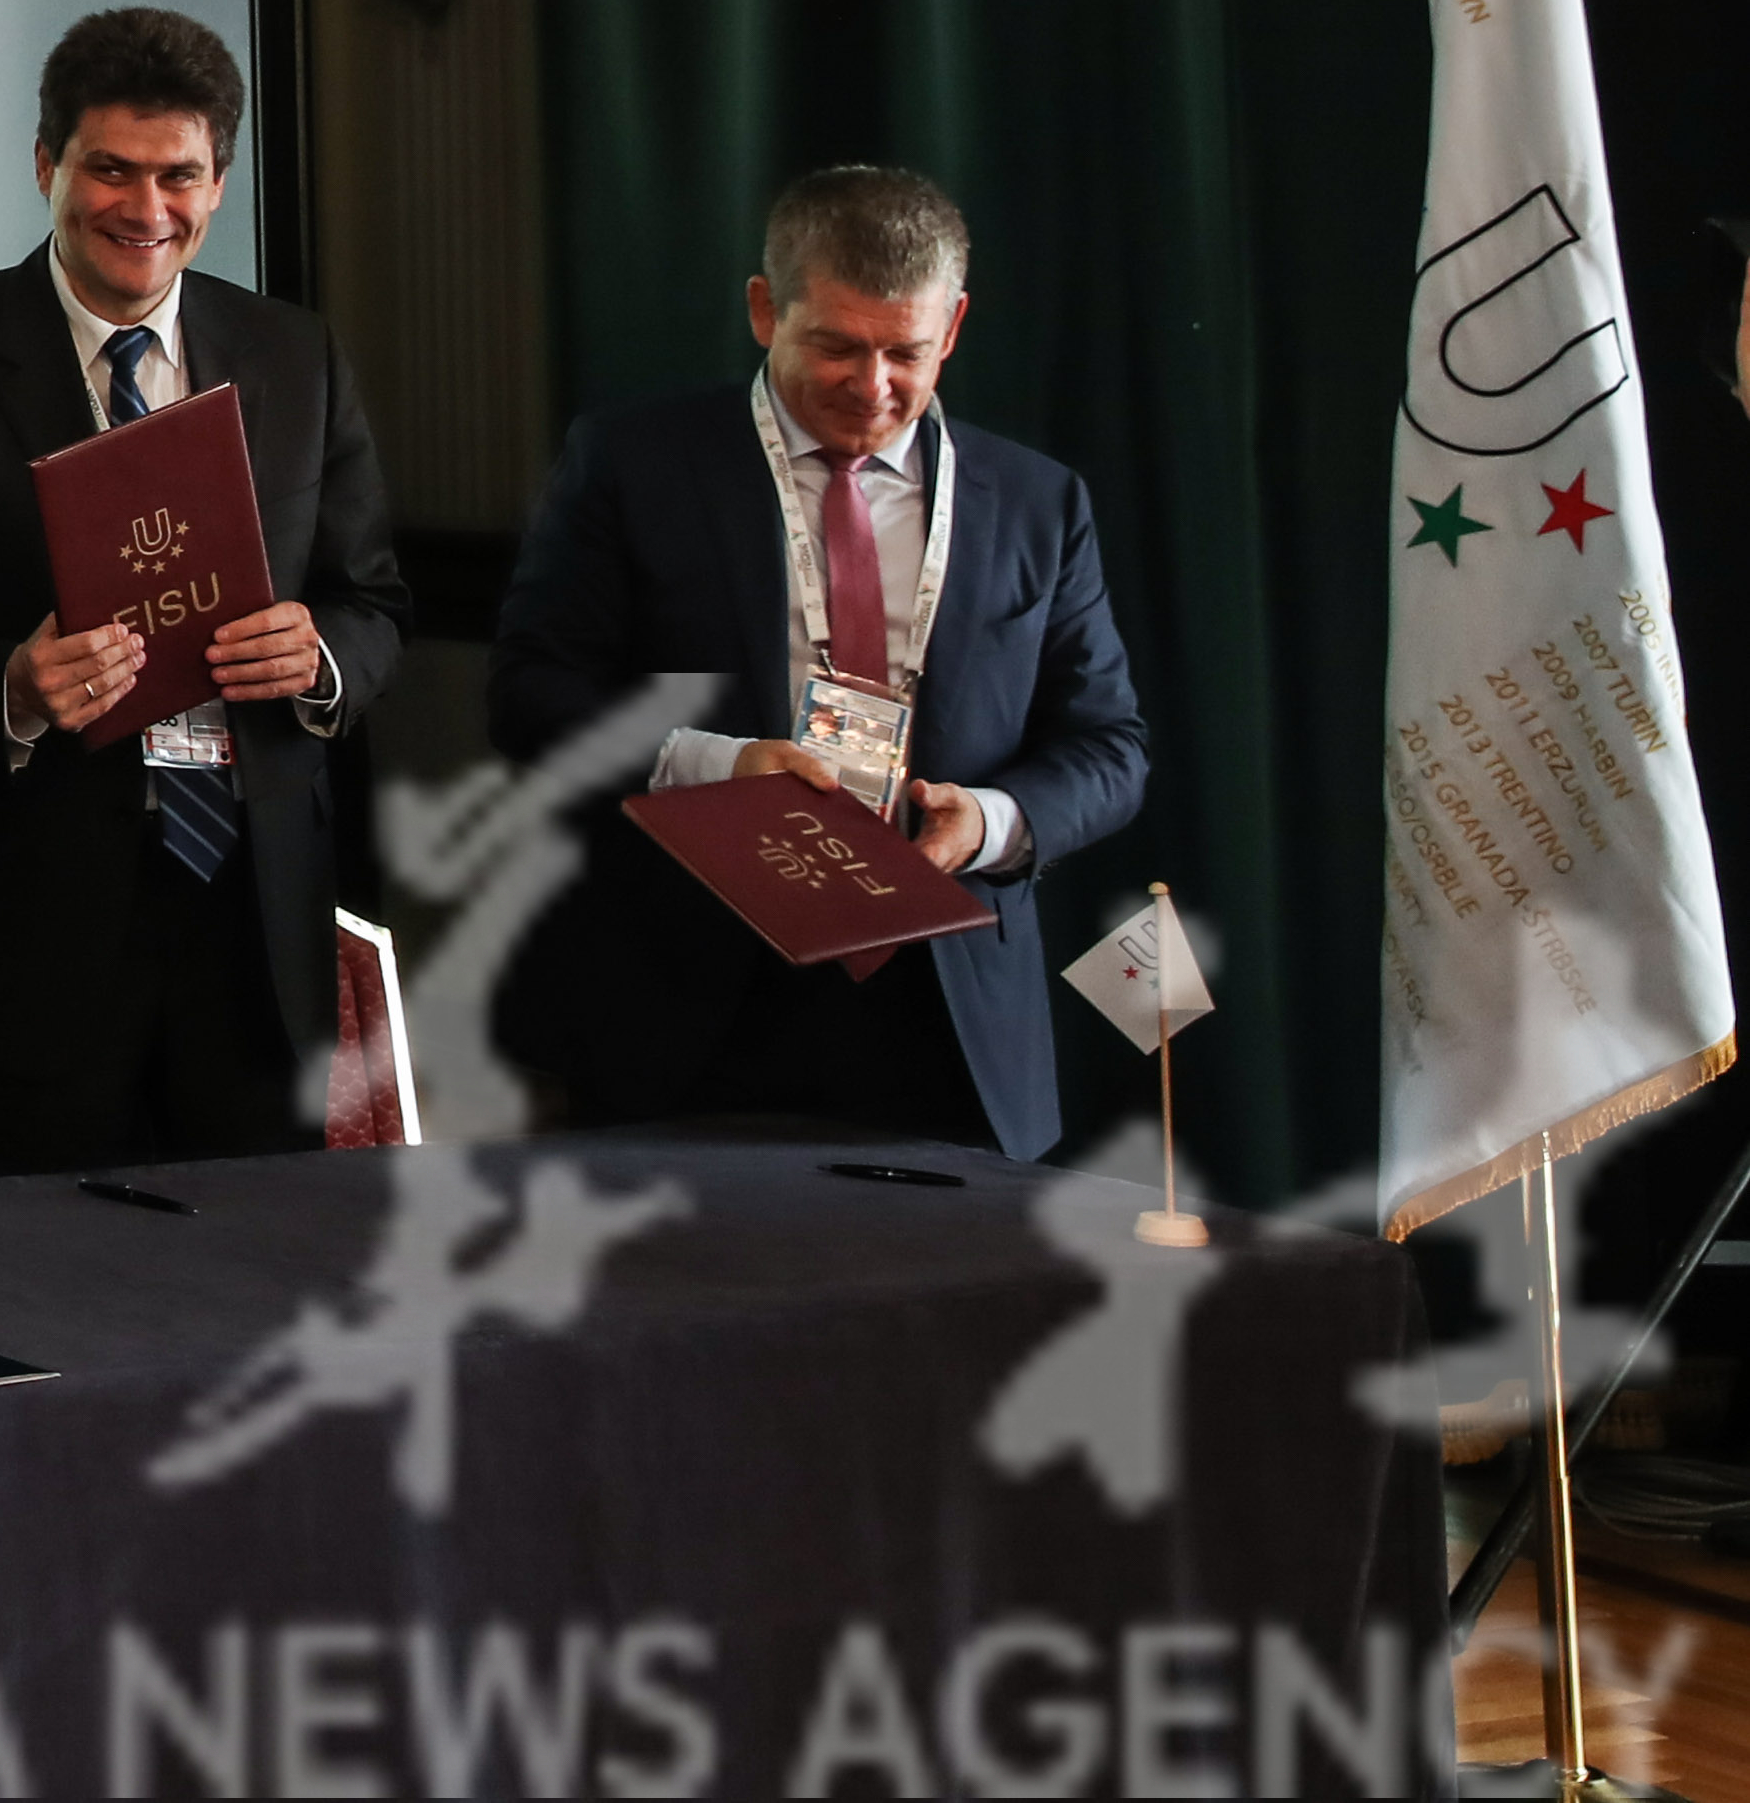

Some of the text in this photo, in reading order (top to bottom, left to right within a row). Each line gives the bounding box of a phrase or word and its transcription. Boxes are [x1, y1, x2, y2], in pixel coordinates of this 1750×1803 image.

[1398, 719, 1444, 781] 2015
[1531, 640, 1634, 801] 2009 HARBIN
[1573, 613, 1669, 754] 2007 TURIN
[1438, 693, 1575, 876] 2013 TRENTINO
[1484, 667, 1609, 853] 2011 ERZURUM
[784, 811, 897, 896] FISU
